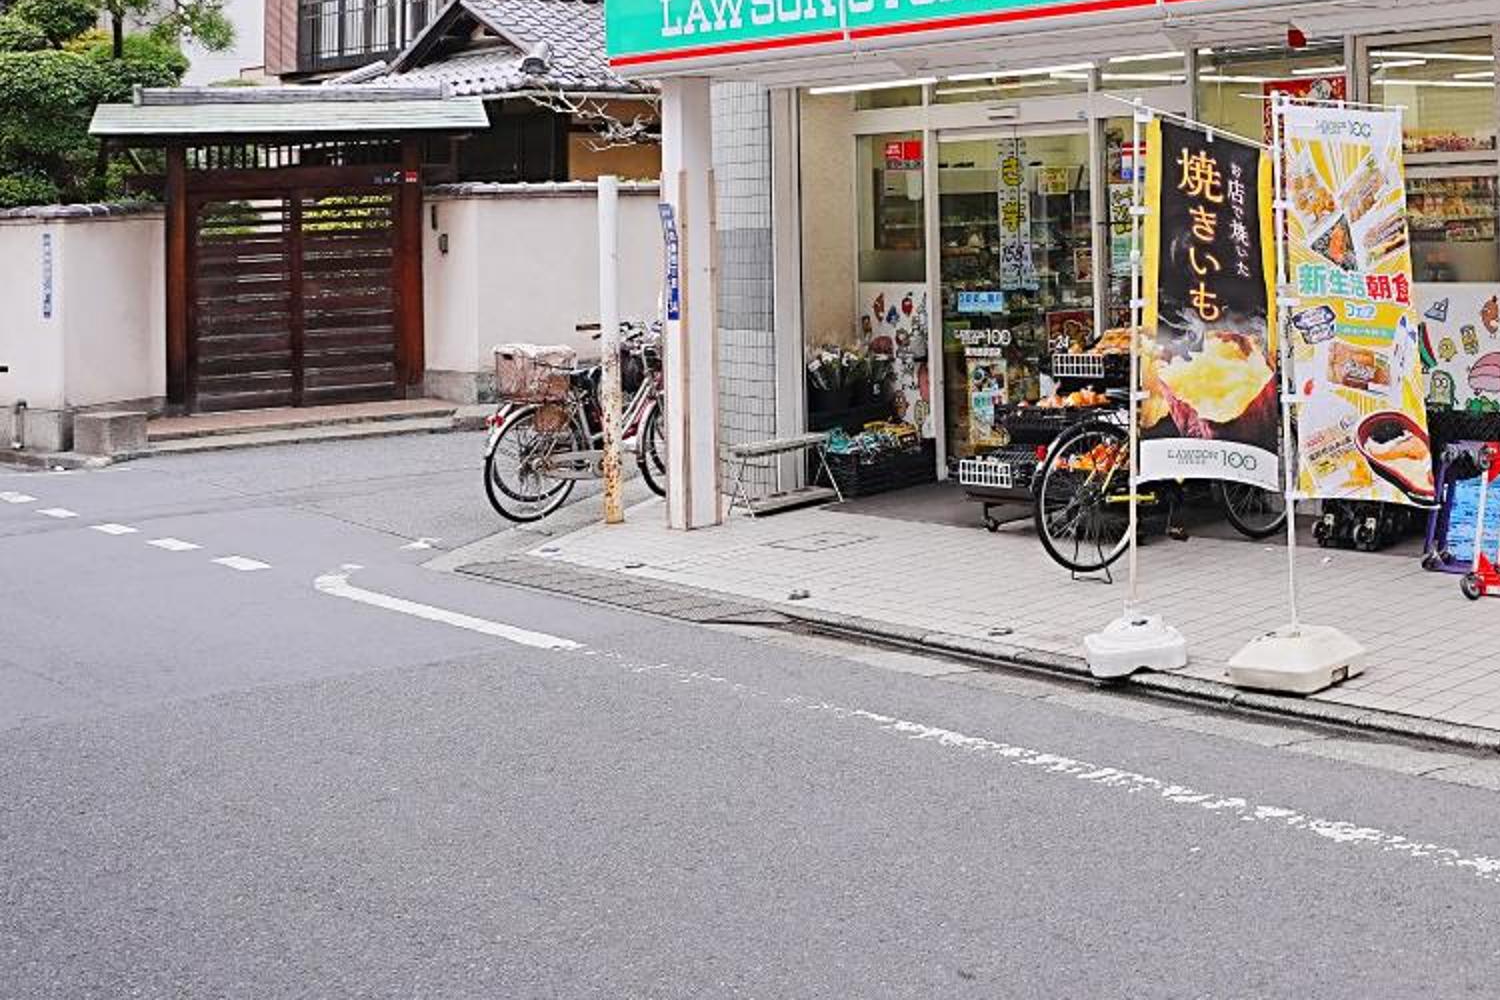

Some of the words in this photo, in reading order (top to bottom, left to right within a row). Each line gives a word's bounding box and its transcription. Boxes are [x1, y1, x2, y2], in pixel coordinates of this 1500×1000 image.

[1176, 146, 1224, 322] 焼きいも
[1219, 449, 1257, 471] 100
